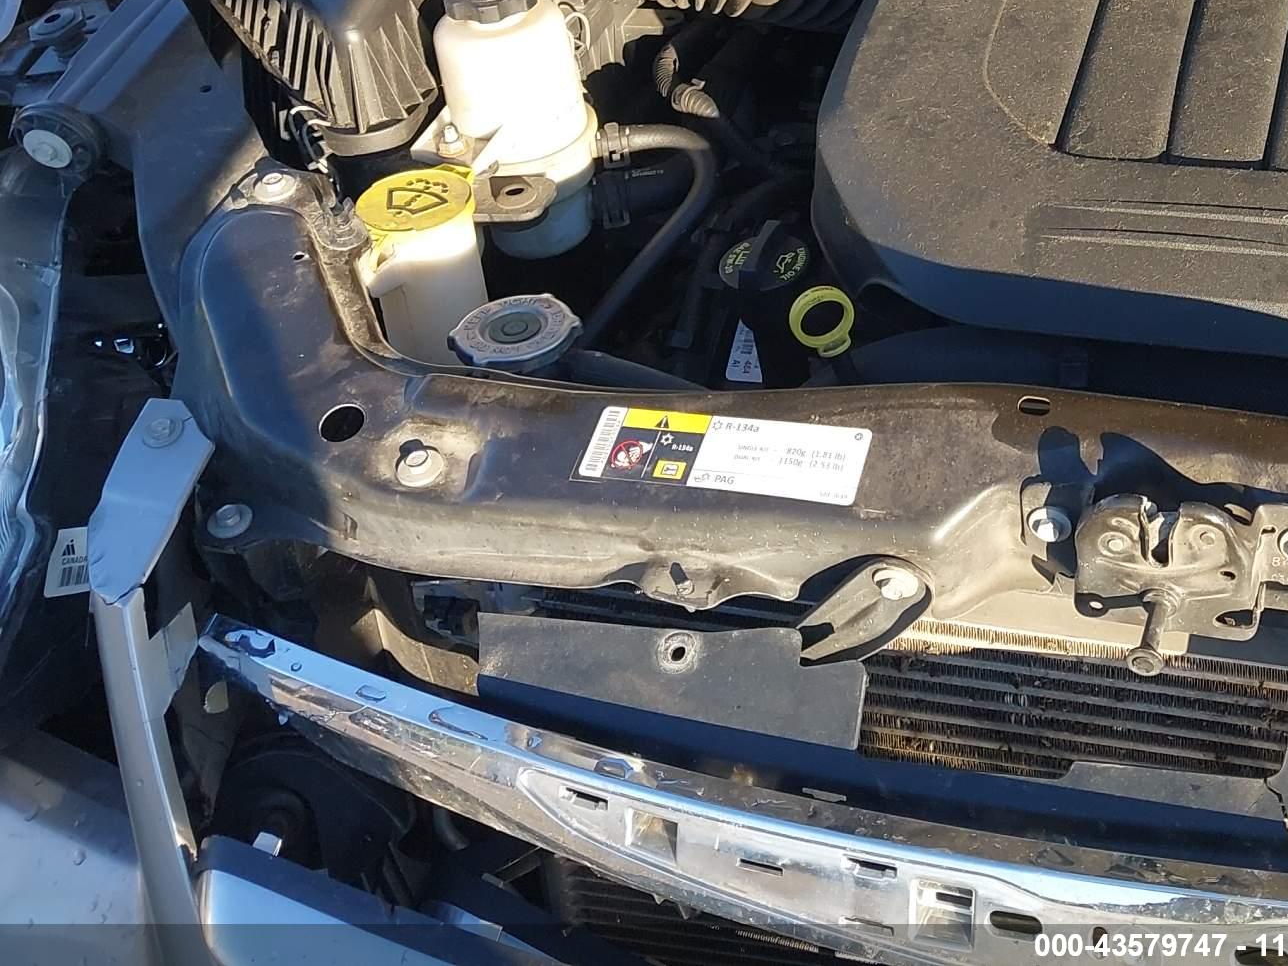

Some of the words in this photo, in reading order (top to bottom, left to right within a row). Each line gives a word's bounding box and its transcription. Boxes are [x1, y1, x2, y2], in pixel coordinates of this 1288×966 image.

[779, 271, 796, 281] OIL
[724, 422, 760, 433] R-134a
[714, 474, 736, 485] PAG
